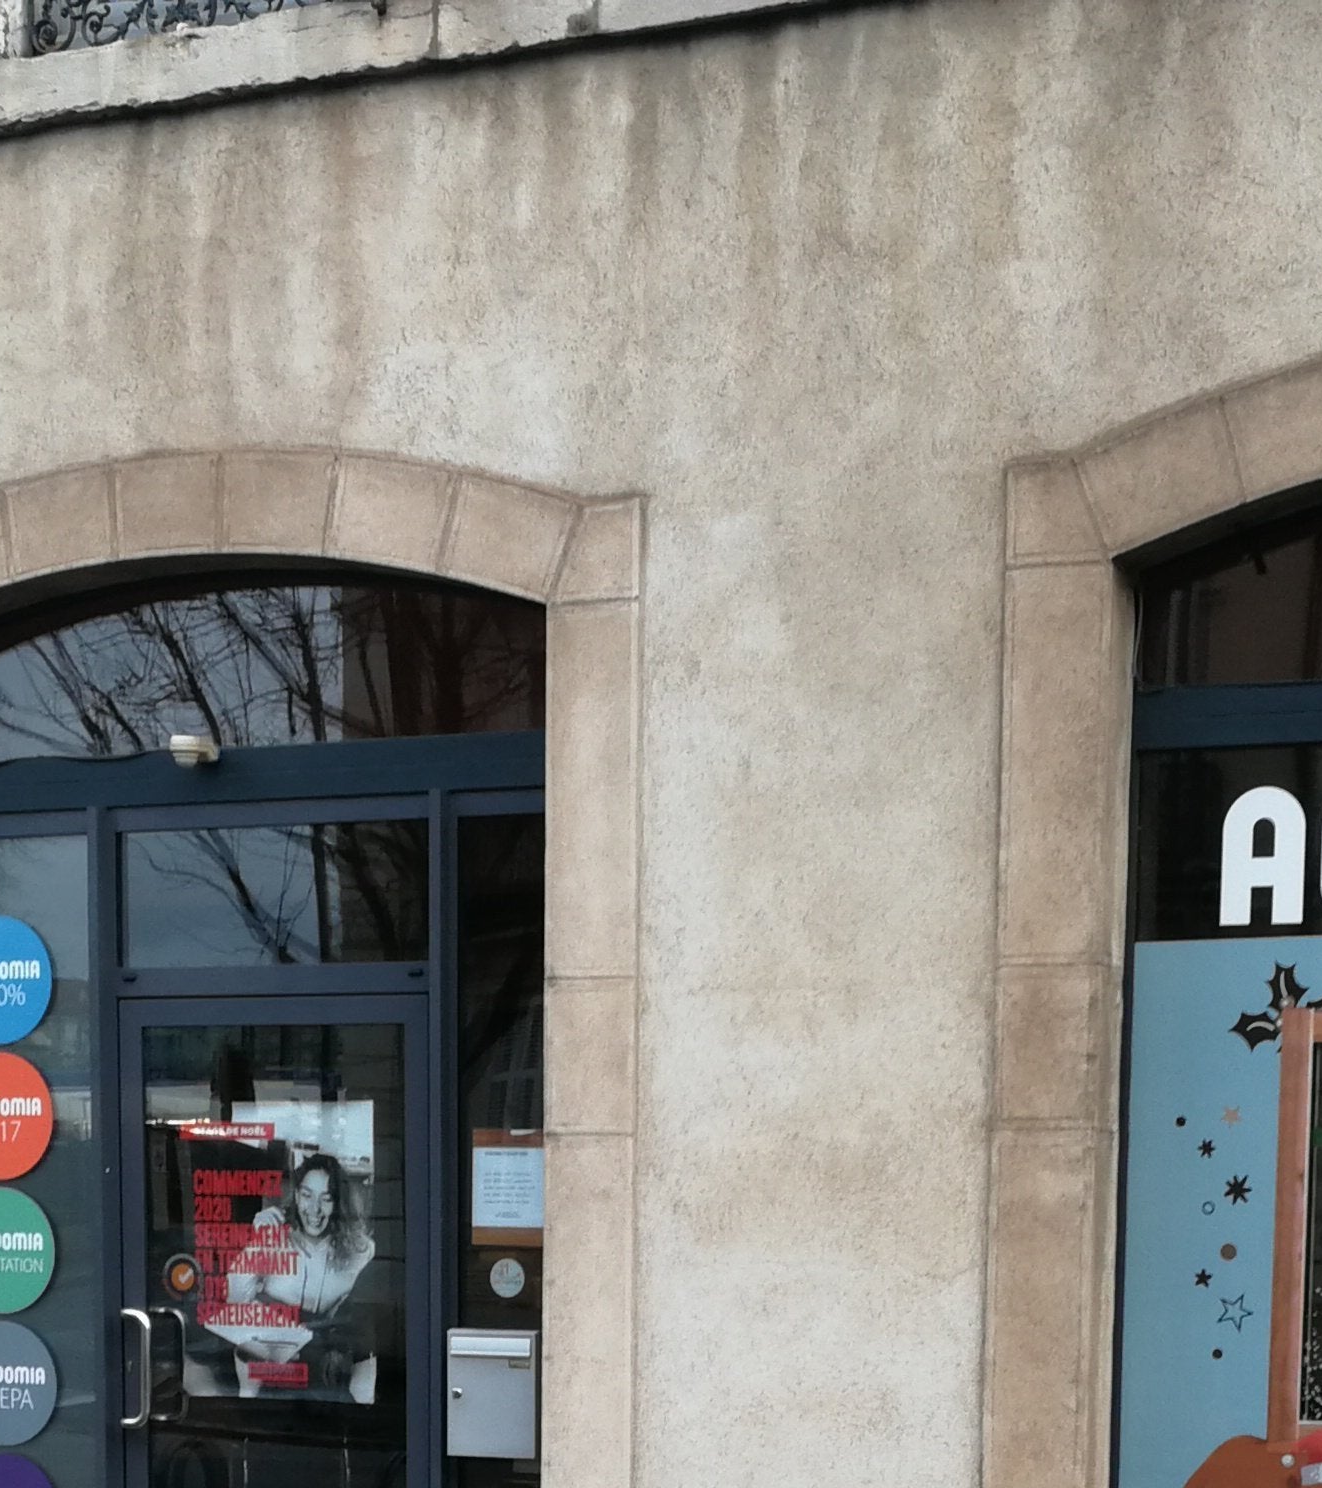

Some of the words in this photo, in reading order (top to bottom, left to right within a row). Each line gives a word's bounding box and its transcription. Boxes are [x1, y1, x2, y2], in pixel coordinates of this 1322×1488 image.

[193, 1170, 284, 1197] COMMENCEZ
[194, 1195, 232, 1221] 2020
[194, 1222, 291, 1248] SEREINEMENT
[218, 1250, 300, 1276] TERMINANT
